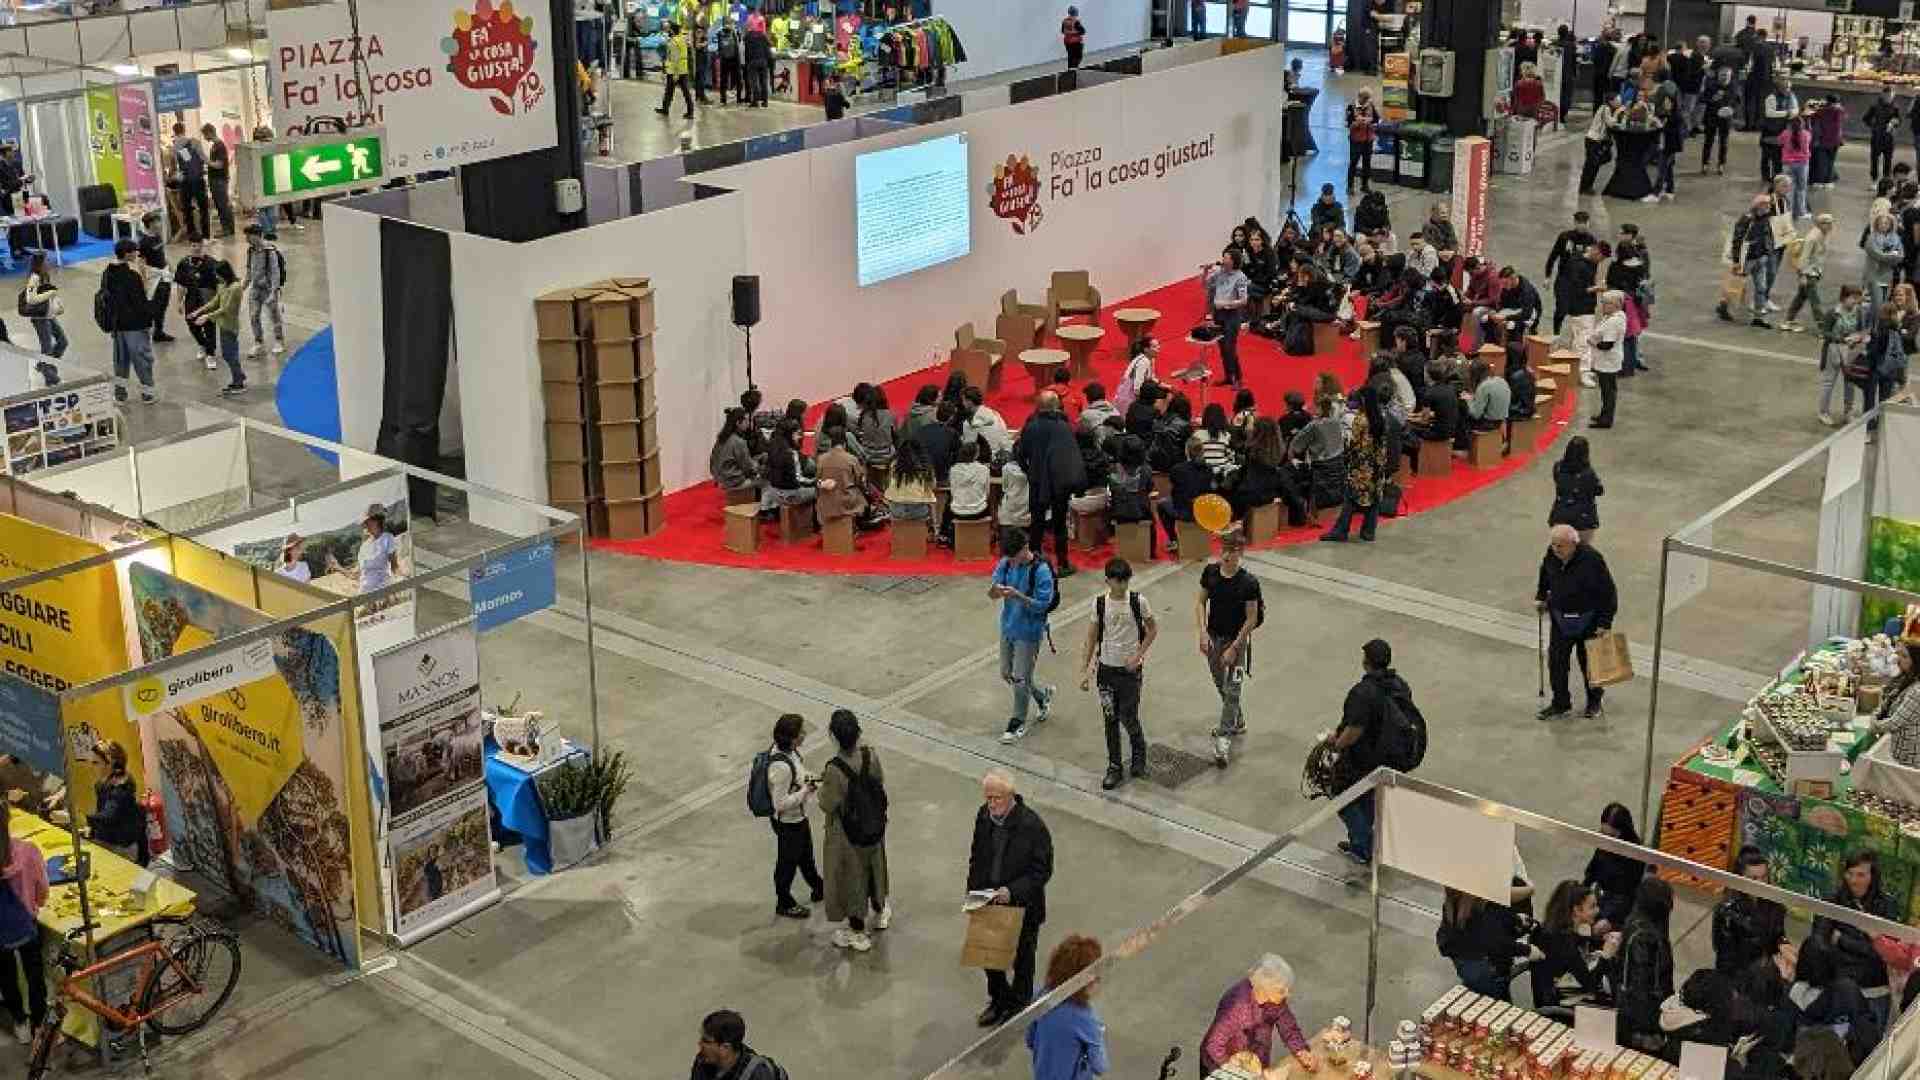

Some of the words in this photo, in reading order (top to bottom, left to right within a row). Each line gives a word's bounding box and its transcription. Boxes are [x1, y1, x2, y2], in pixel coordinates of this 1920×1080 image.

[279, 34, 384, 72] PIAZZA
[467, 43, 524, 82] GIUSTA!
[283, 75, 325, 109] Fa'
[370, 66, 433, 96] cosa
[1050, 147, 1102, 172] Piazza
[1050, 169, 1079, 200] Fa'
[1086, 167, 1102, 191] la
[1108, 157, 1149, 184] cosa
[1154, 133, 1214, 178] giusta!
[474, 590, 524, 615] Mannos
[167, 663, 234, 697] girolibero
[397, 666, 461, 704] MANNOS
[200, 703, 281, 754] girolibero.it
